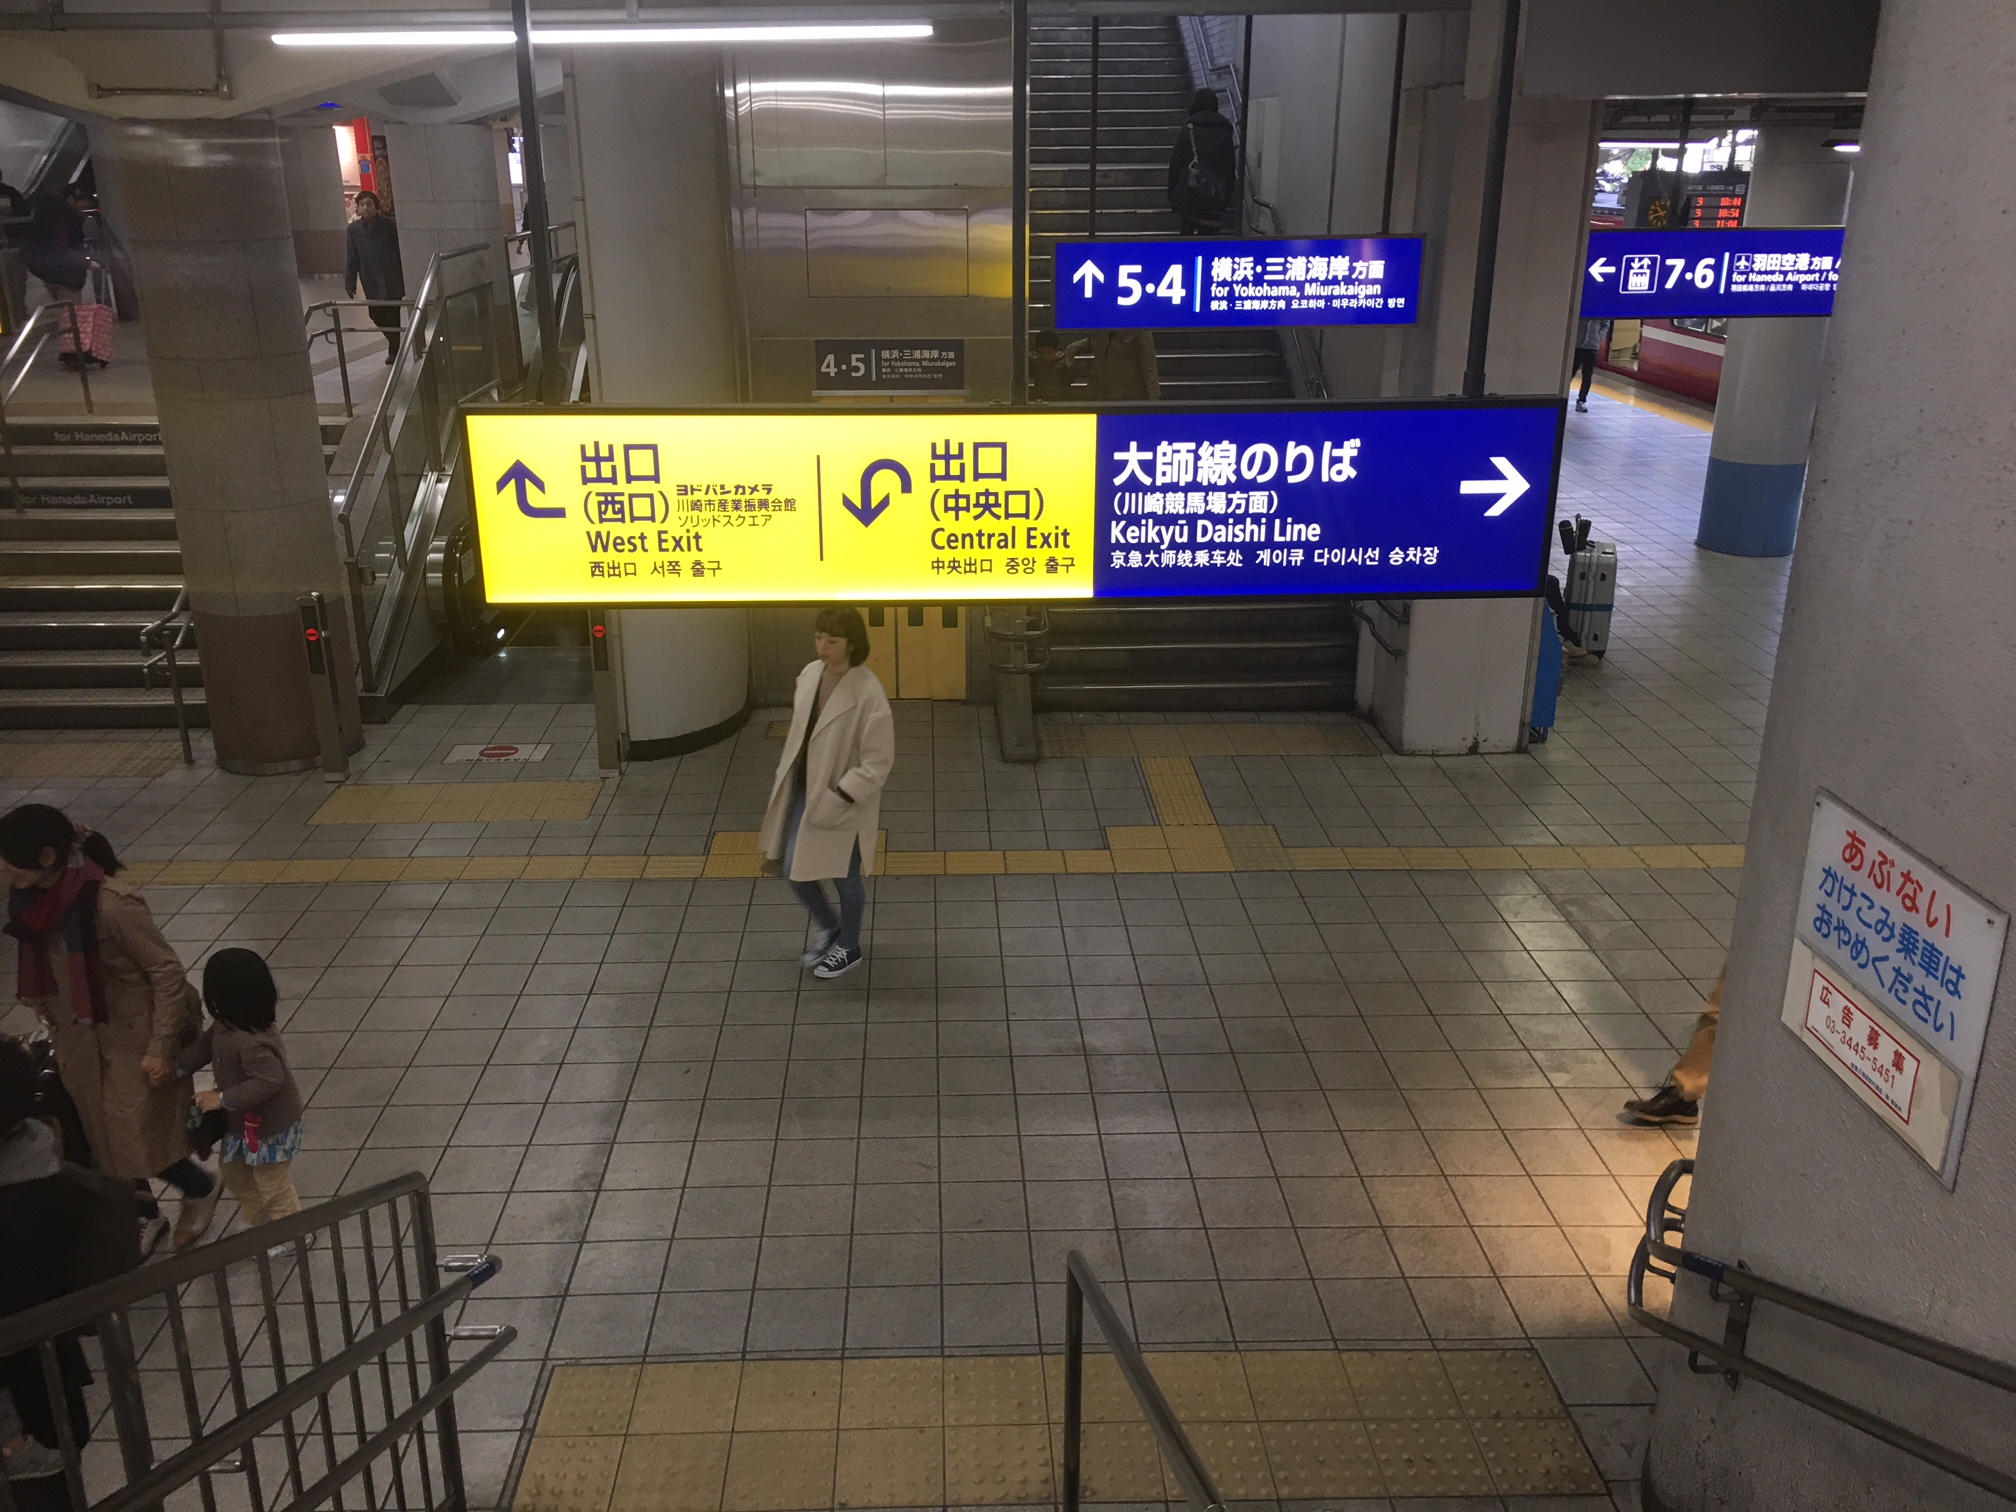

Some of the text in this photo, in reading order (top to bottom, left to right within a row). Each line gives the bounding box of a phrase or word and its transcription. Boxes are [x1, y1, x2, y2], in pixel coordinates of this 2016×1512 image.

[1210, 281, 1383, 299] for Yokohama, Miurakaigan
[1731, 270, 1747, 283] for
[1748, 270, 1785, 283] Haneda
[1785, 270, 1821, 285] Airport
[881, 359, 957, 369] for Yokohama, Miurakaigan
[580, 440, 661, 486] 出口
[929, 438, 1008, 484] 出口
[1112, 438, 1361, 487] 大師線のりば
[676, 483, 773, 497] ヨドバシカメラ
[583, 490, 670, 525] (西口)
[677, 497, 797, 513] 川崎市産業振興会館
[930, 487, 1044, 522] (中央口)
[677, 514, 773, 528] ソリッドスクエア
[1110, 517, 1321, 550] Keikyū Daishi Line
[586, 528, 703, 553] West Exit
[930, 525, 1071, 551] Central Exit
[589, 560, 637, 578] 西出口
[650, 559, 722, 578] 서쪽 출구
[931, 556, 993, 575] 中央出口
[1004, 556, 1076, 575] 중앙 출구
[1255, 546, 1440, 567] 게이큐 다이시선 승차장
[1841, 829, 1951, 938] あぶない
[1813, 903, 1955, 1041] おやめください
[1819, 985, 1906, 1076] 広告募集
[1825, 1015, 1896, 1089] 03-3445-5451
